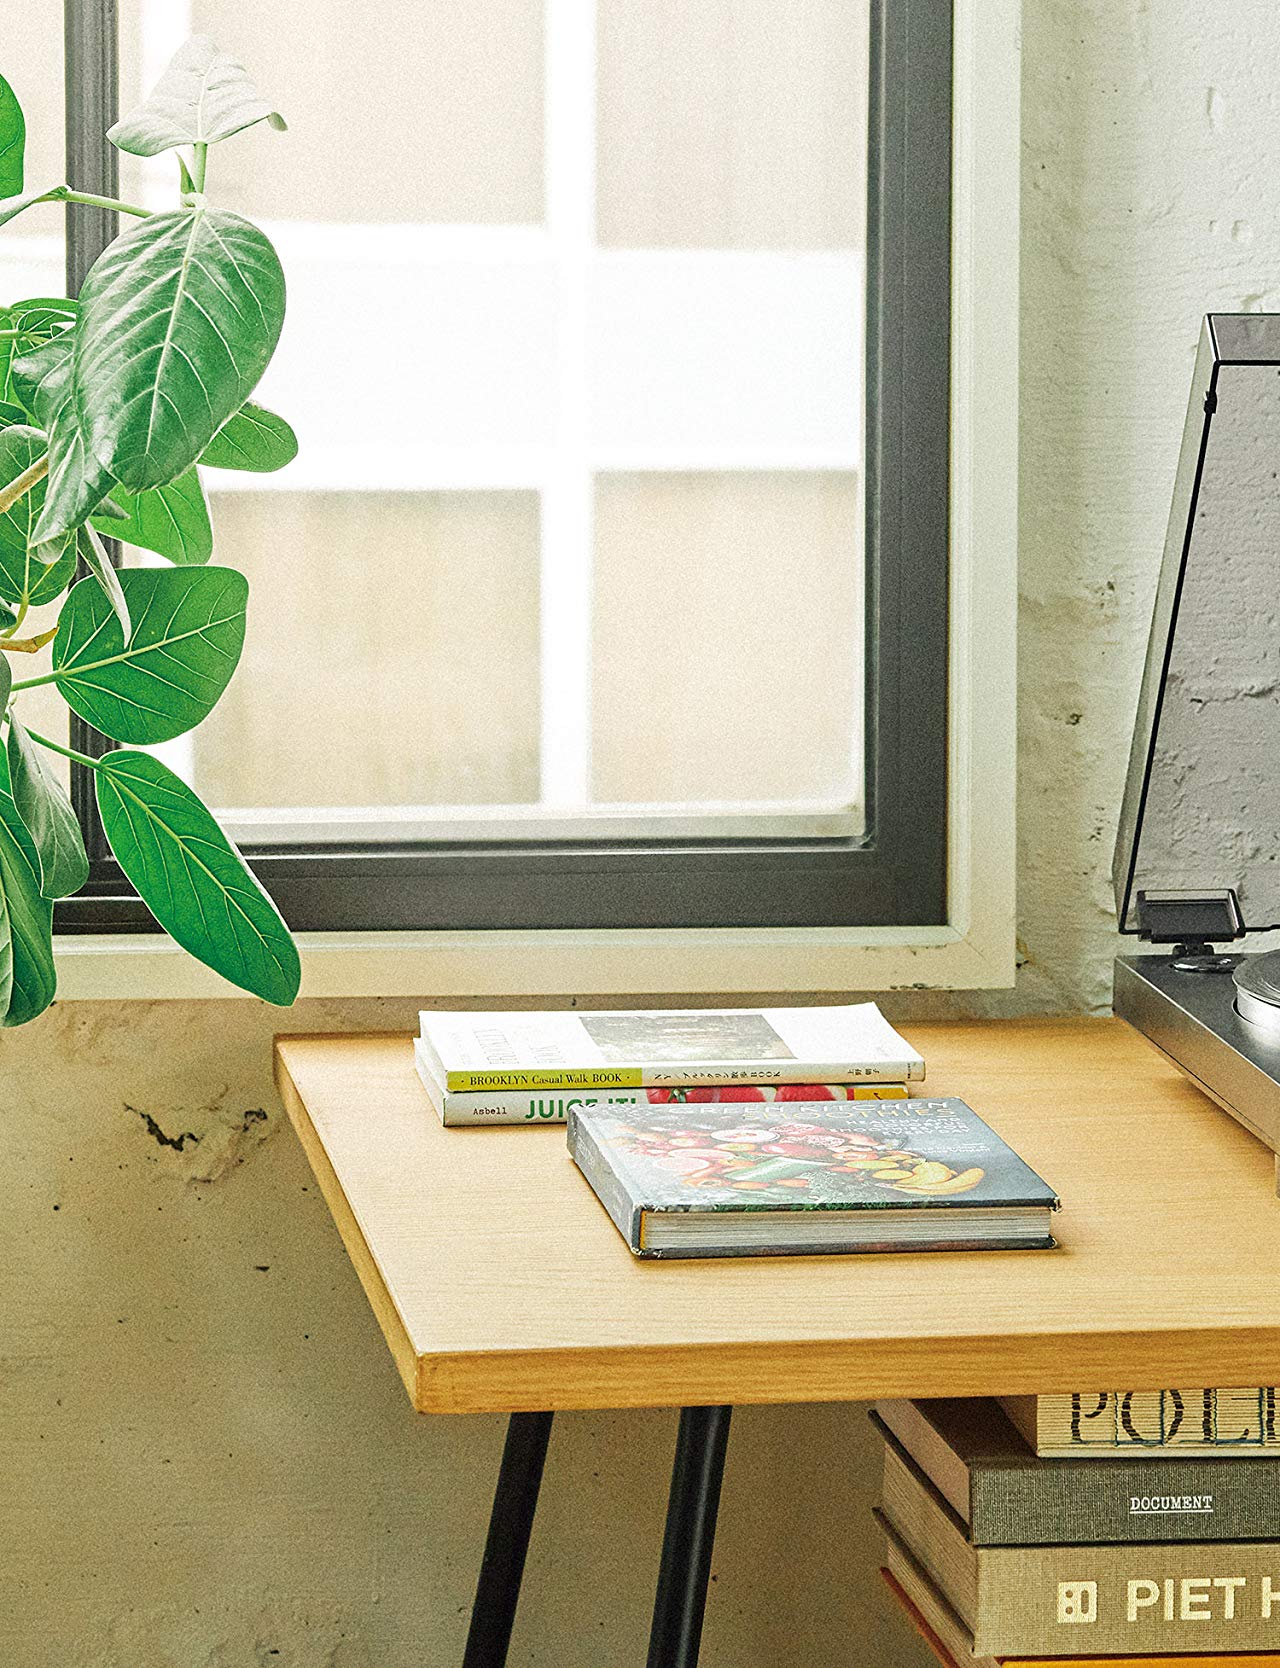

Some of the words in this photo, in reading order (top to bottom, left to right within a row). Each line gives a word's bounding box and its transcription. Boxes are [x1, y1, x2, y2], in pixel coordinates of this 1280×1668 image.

[470, 1074, 528, 1086] BROOKLYN
[532, 1074, 563, 1085] Casual
[566, 1073, 589, 1084] Walk
[592, 1073, 622, 1083] BOOK
[473, 1106, 508, 1116] Asbell
[525, 1098, 598, 1119] JUI
[668, 1106, 784, 1114] GREEN
[799, 1103, 949, 1112] KITCHEN
[742, 1109, 955, 1120] SMOOTHIES
[1129, 1496, 1213, 1512] DOCUMENT
[1127, 1577, 1246, 1622] PIET
